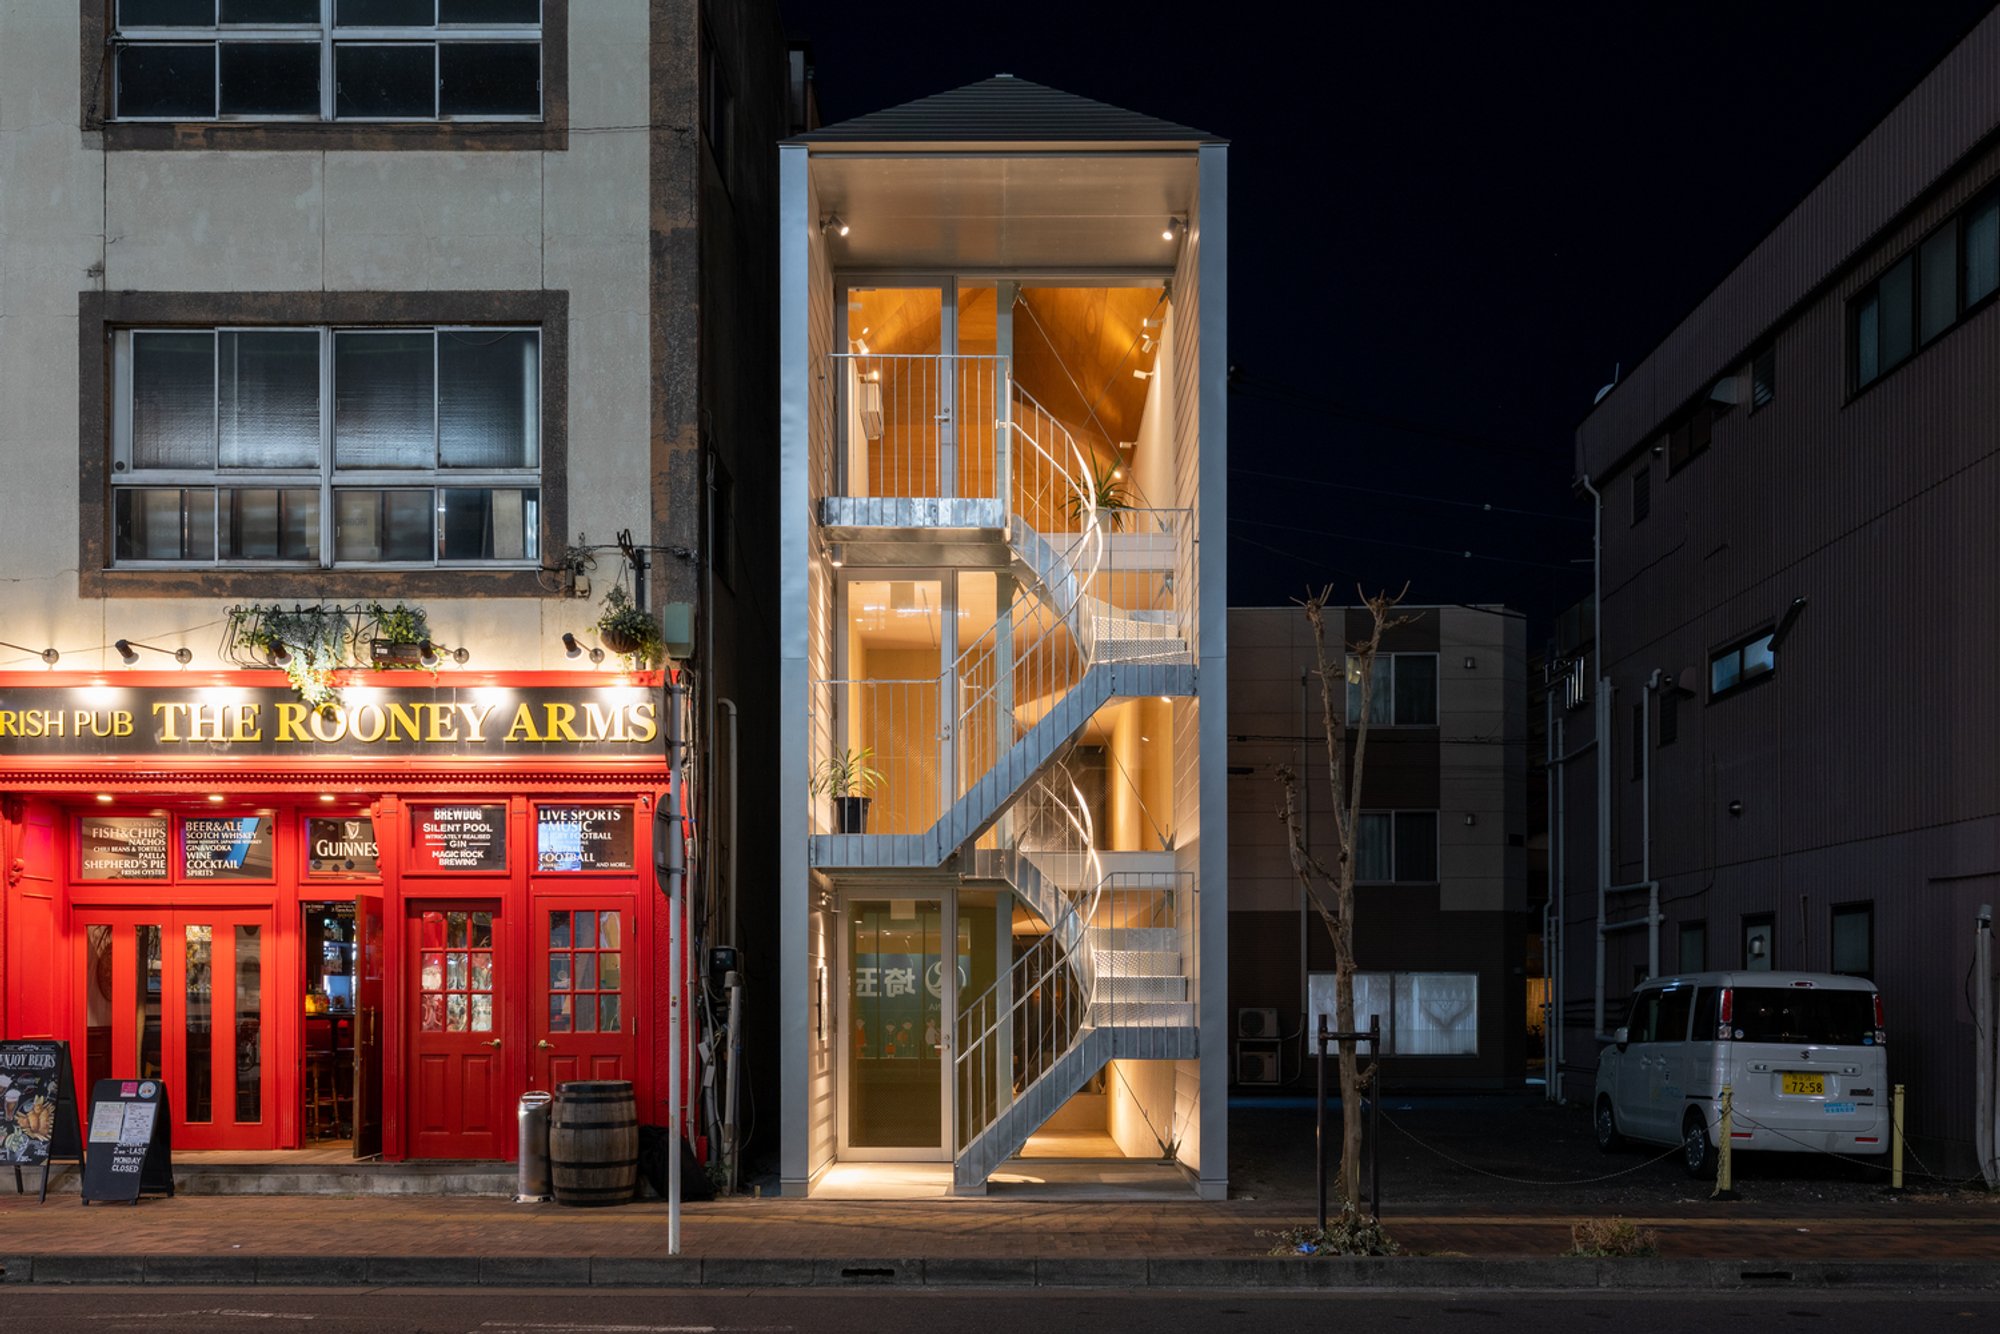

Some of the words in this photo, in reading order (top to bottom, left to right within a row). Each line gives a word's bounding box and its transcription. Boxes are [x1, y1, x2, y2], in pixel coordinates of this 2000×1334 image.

[0, 709, 66, 737] RISH
[74, 709, 134, 737] PUB
[152, 702, 262, 743] THE
[274, 702, 495, 743] ROONEY
[503, 702, 657, 743] ARMS
[540, 809, 567, 820] LIVE
[571, 809, 621, 821] SPORTS
[423, 823, 461, 832] SILENT
[463, 823, 493, 832] POOL
[549, 821, 592, 832] MUSIC
[129, 838, 166, 846] NACHOS
[150, 859, 166, 869] PIE
[186, 859, 240, 869] COCKTAIL
[28, 1054, 56, 1069] BEERS
[1792, 1082, 1823, 1093] 72-58
[113, 1157, 141, 1165] MONDAY
